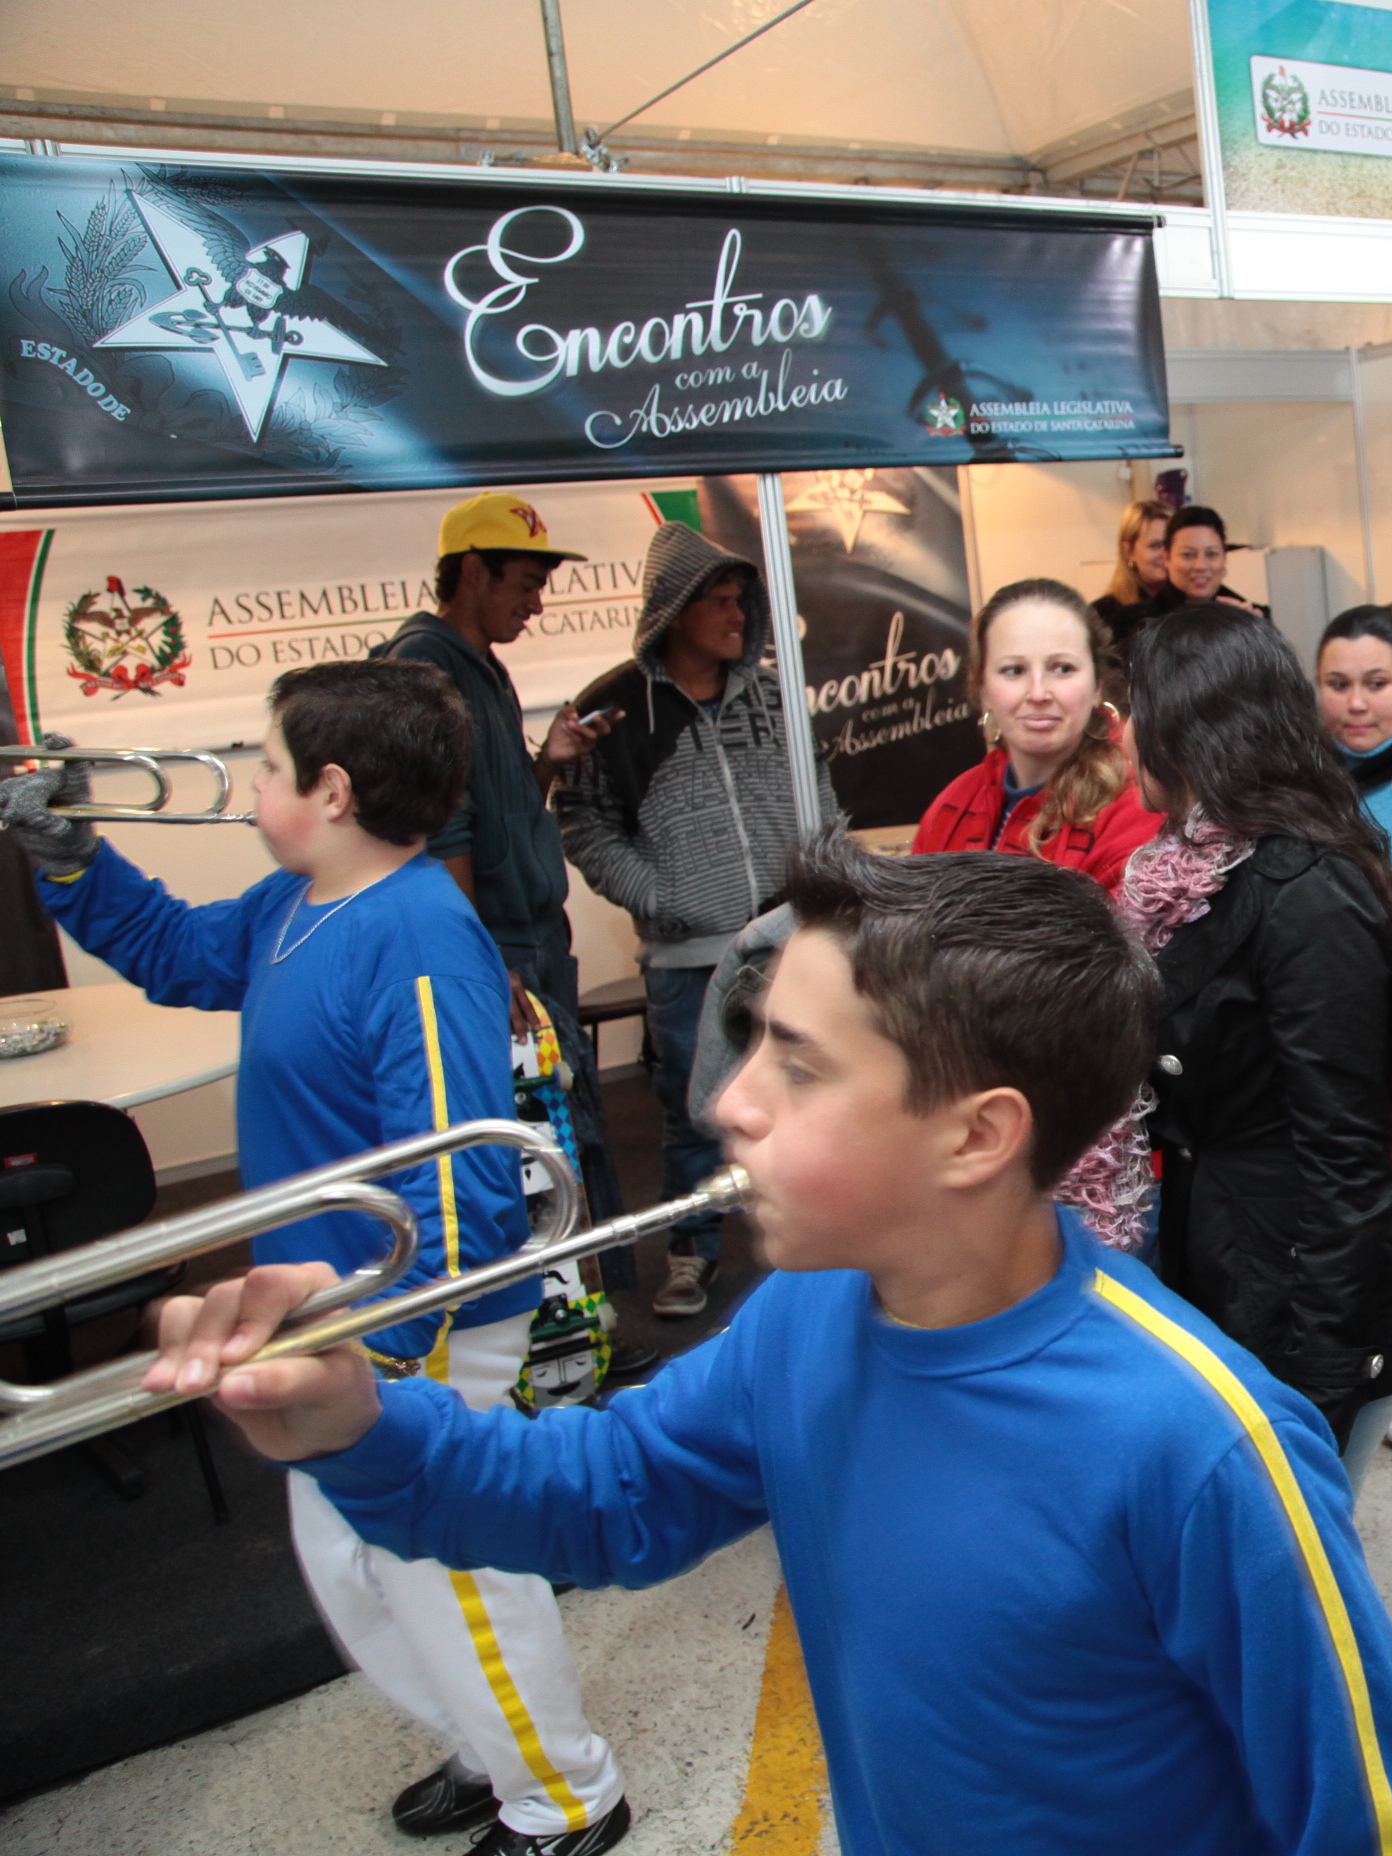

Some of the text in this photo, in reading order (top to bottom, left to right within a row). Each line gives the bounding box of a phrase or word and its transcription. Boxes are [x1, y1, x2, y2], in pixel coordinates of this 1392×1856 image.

[1318, 119, 1341, 135] DO
[444, 205, 832, 396] Encontros
[20, 339, 131, 421] ESTADO DE
[674, 361, 763, 390] com a
[584, 348, 848, 449] Assembleia
[969, 400, 1134, 416] ASSEMBLEIA LEGISLATIVA
[971, 419, 1135, 434] DO ESTADO DE SANTA CATARINA
[208, 578, 438, 627] ASSEMBLEIA
[539, 605, 642, 636] CATARI
[210, 630, 388, 670] DO ESTADO
[804, 611, 962, 717] ncontros
